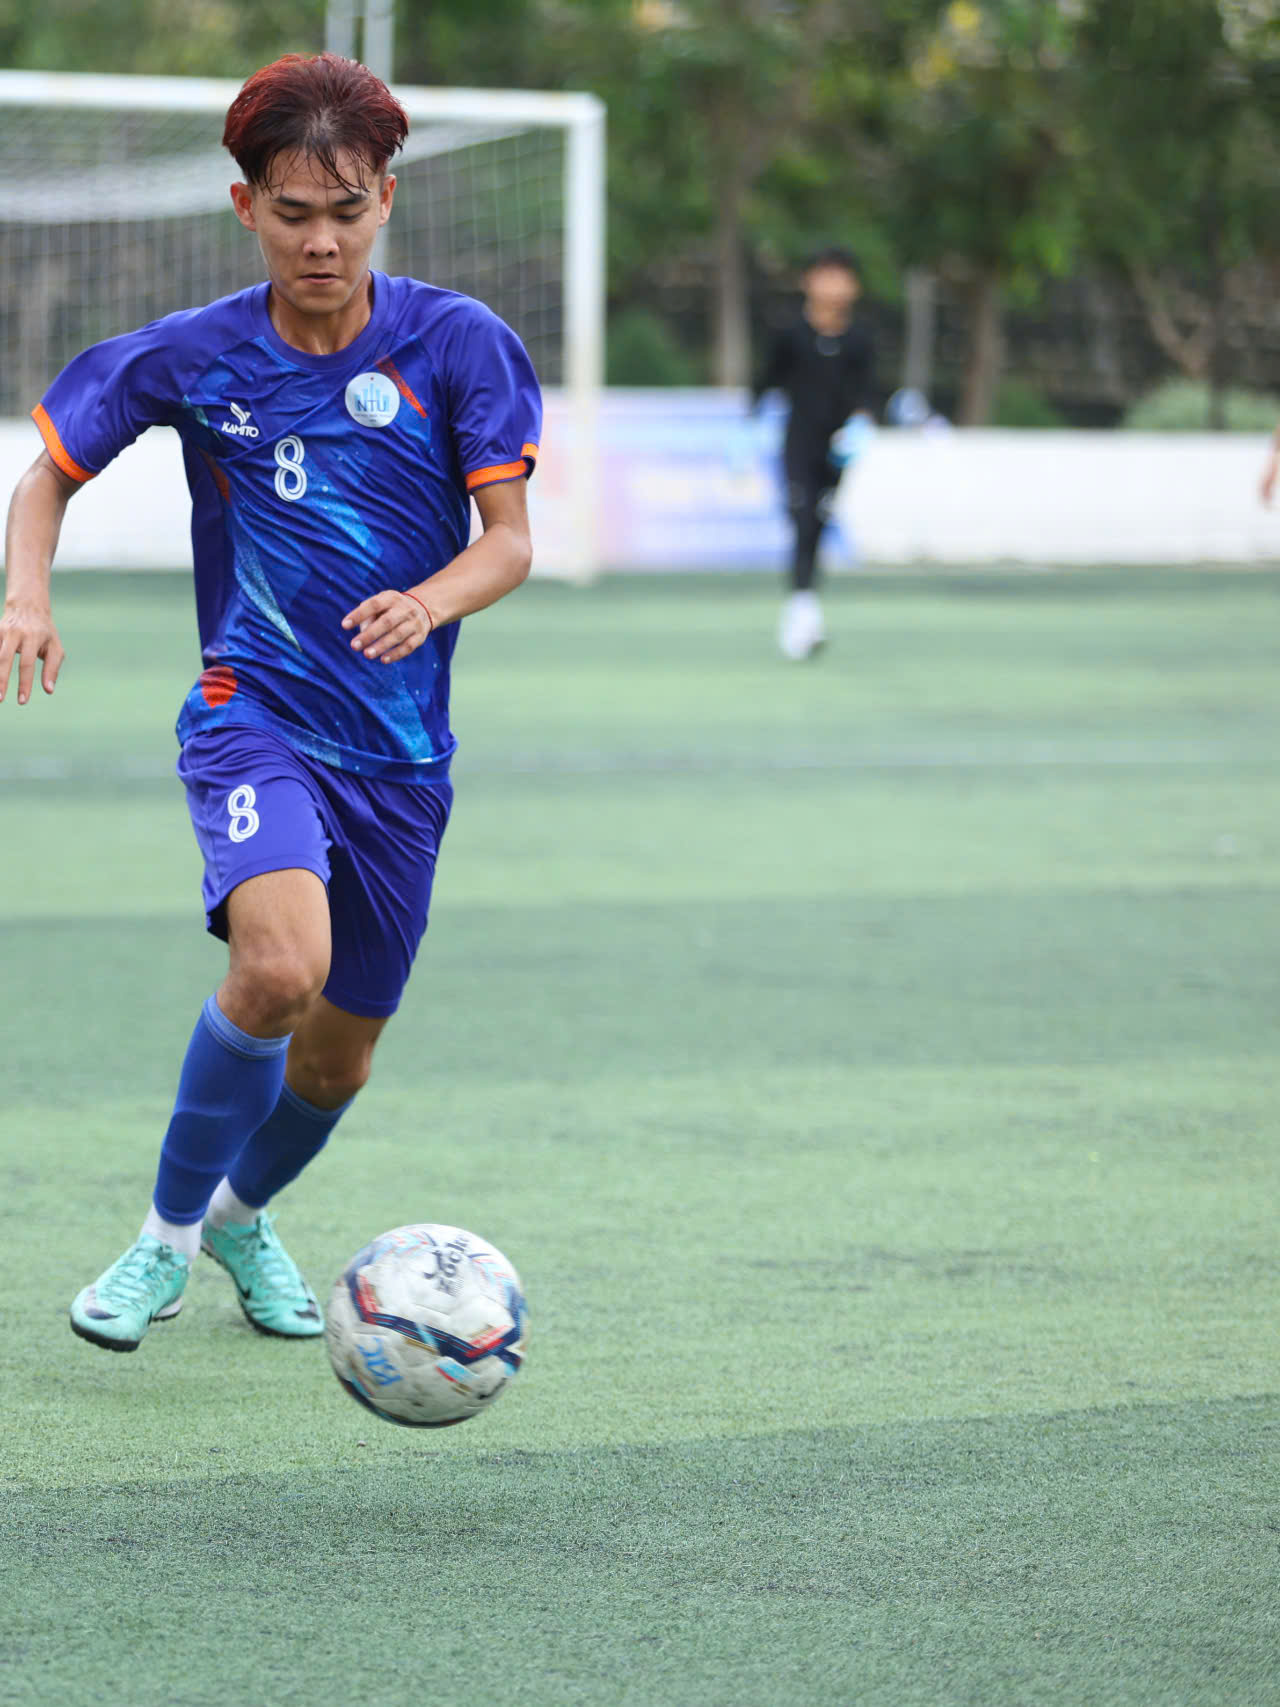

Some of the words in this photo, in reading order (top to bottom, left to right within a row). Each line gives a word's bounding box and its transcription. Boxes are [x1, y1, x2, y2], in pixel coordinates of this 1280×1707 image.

[357, 399, 387, 412] NTU
[221, 421, 259, 437] KAMITO
[274, 435, 307, 502] 8
[227, 784, 260, 843] 8
